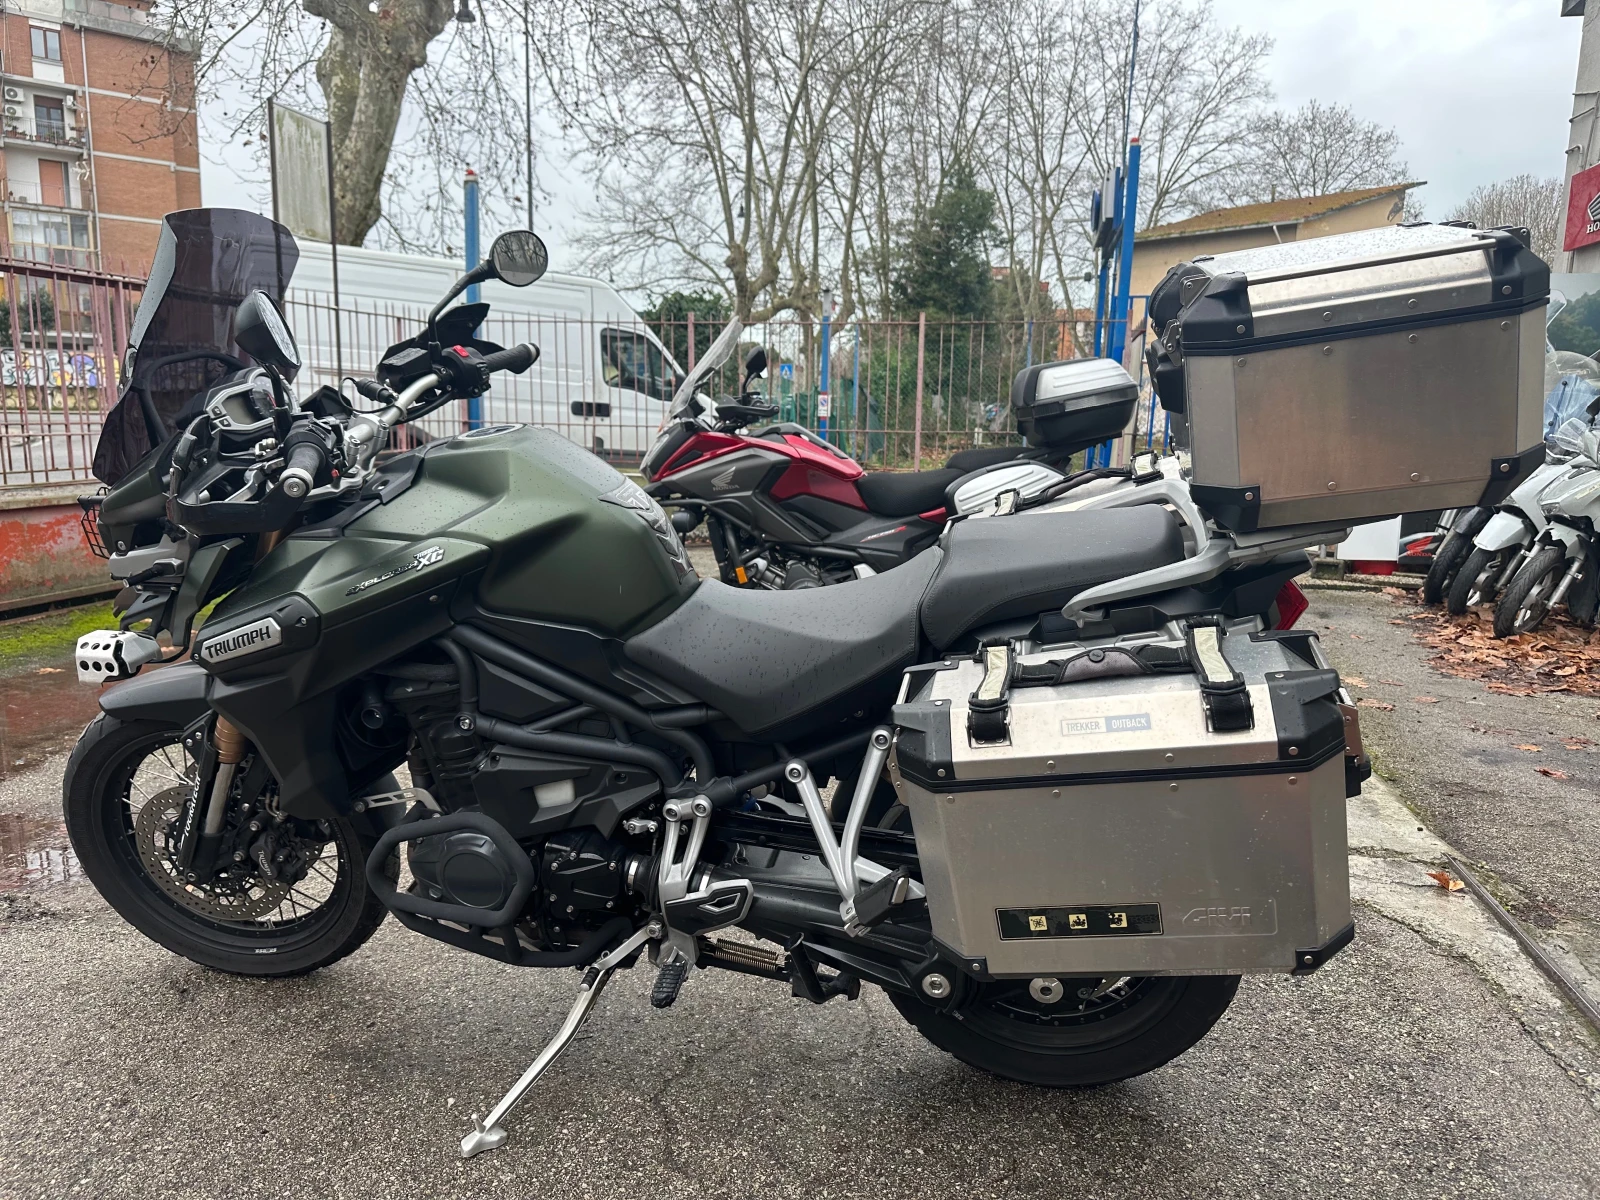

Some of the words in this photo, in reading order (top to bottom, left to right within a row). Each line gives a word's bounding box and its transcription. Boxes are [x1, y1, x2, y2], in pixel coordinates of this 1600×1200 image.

[1581, 221, 1600, 234] HO
[416, 549, 445, 572] XC
[205, 626, 271, 658] TRIUMPH
[1066, 721, 1100, 733] TREKKER
[1111, 717, 1147, 729] OUTBACK
[258, 851, 272, 876] TRIUMPH
